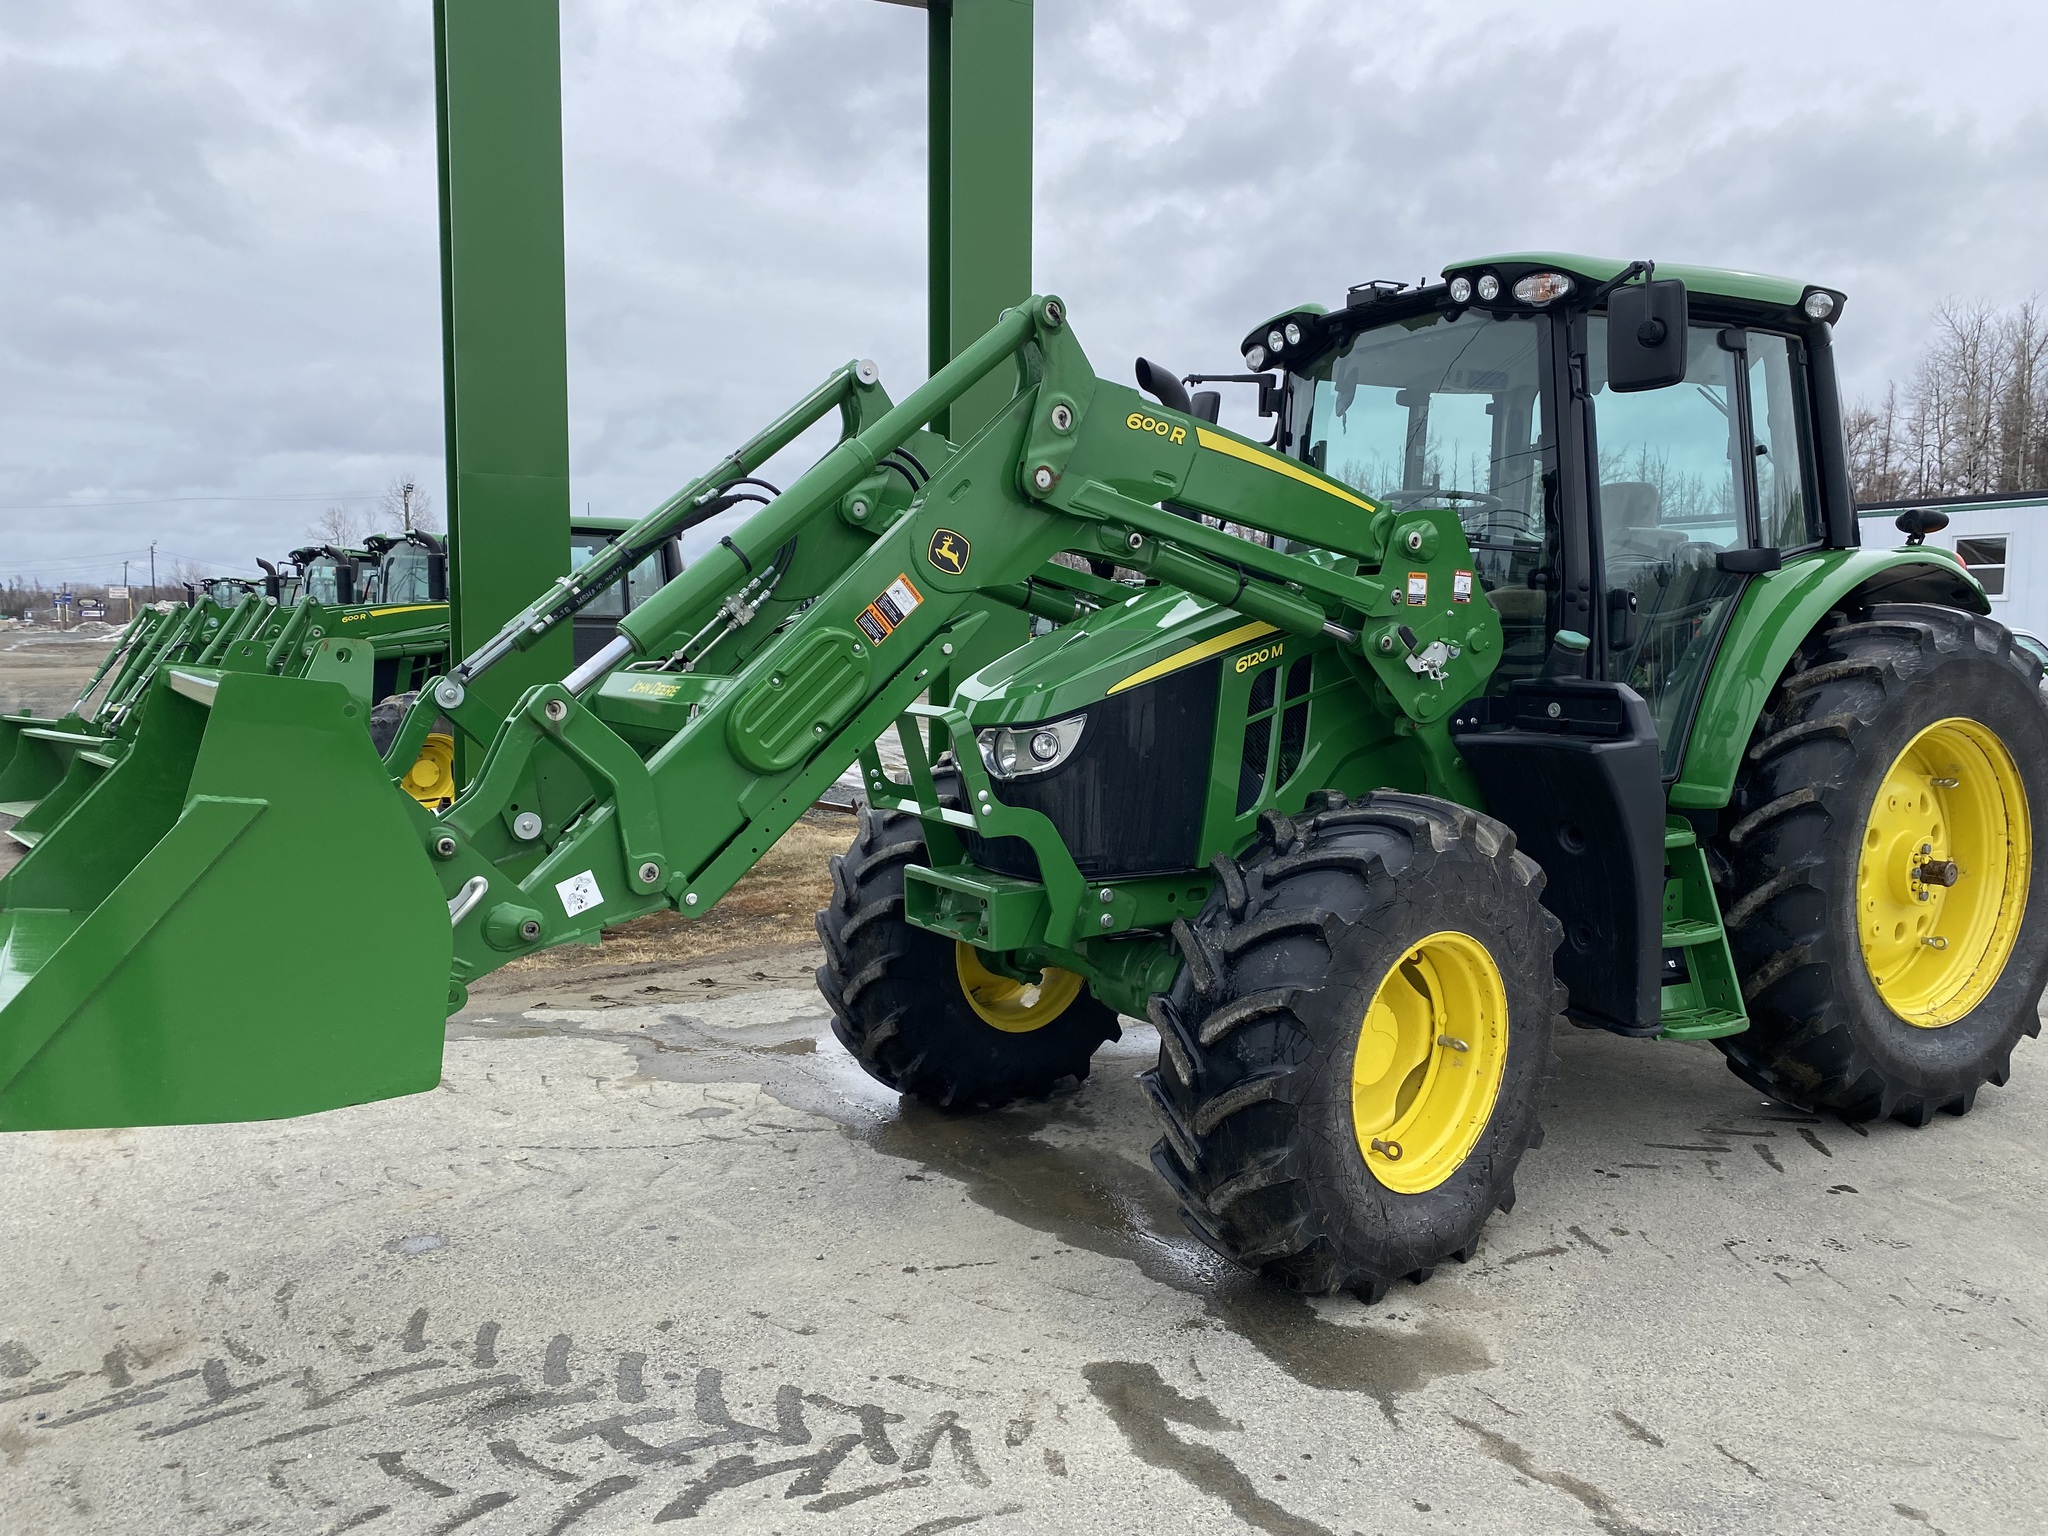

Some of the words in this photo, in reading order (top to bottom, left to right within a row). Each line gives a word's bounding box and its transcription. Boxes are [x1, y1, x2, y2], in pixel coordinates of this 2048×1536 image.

[1126, 412, 1169, 436] 600
[1168, 426, 1187, 445] R
[575, 589, 596, 605] MSHA
[342, 615, 359, 623] 600
[1235, 648, 1269, 673] 6120
[1271, 643, 1283, 659] M
[627, 679, 653, 694] JOHN
[648, 681, 682, 698] DEERE
